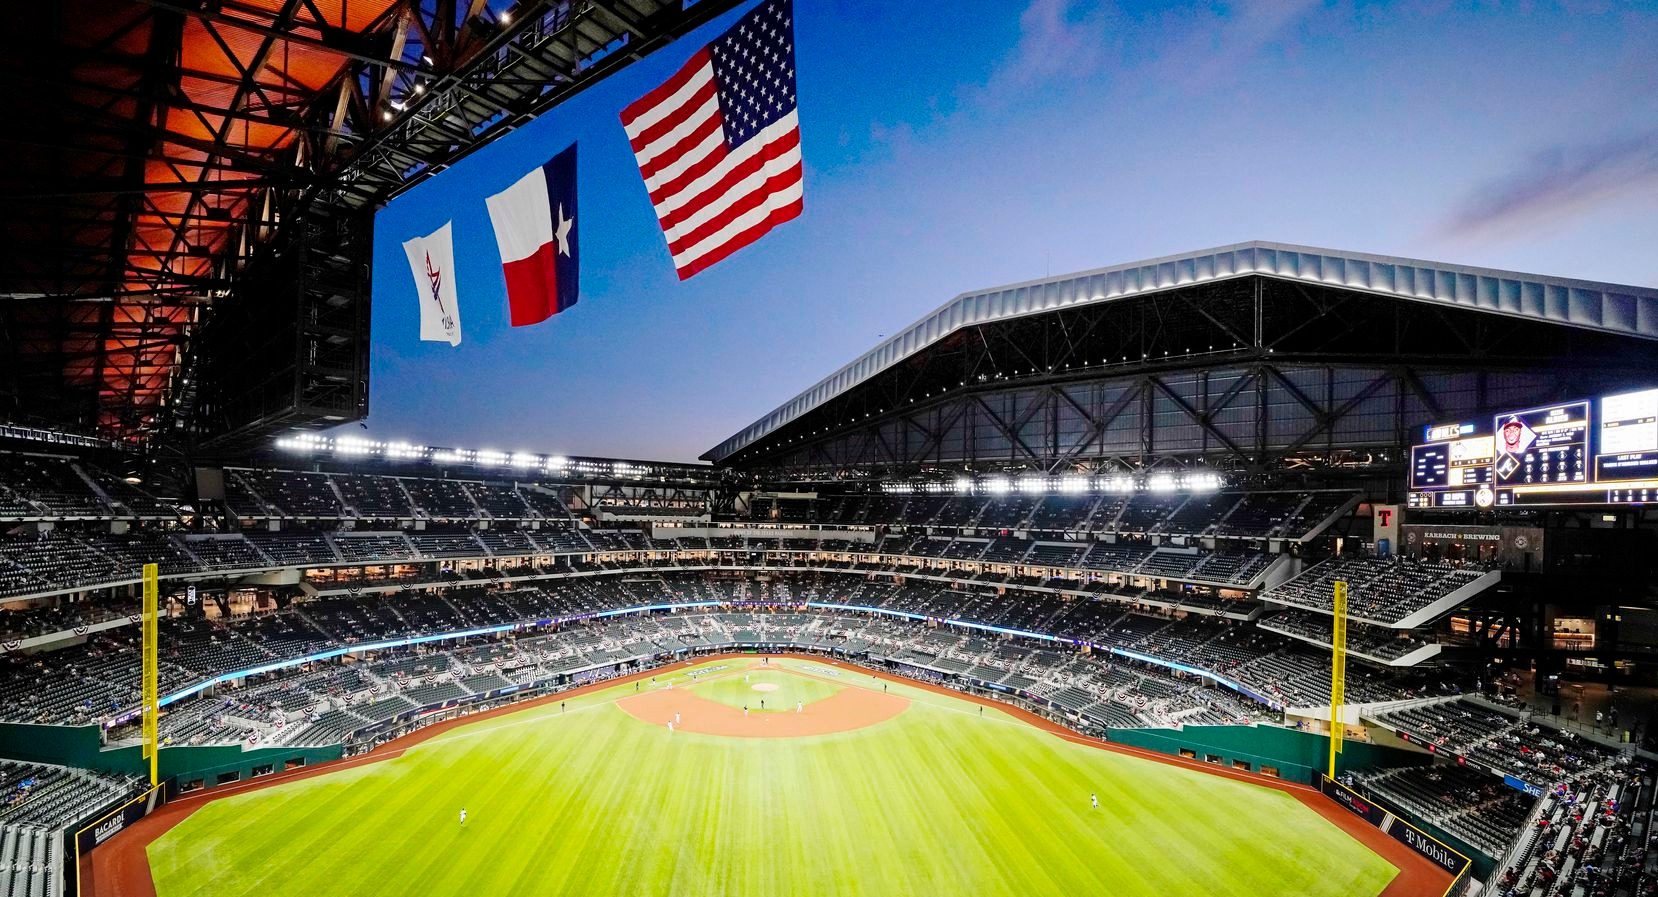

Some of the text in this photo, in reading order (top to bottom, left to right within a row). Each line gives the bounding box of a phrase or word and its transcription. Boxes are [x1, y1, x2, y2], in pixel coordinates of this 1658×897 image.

[1378, 510, 1392, 527] T
[1424, 532, 1500, 541] KARBACH BREWING
[1465, 760, 1481, 771] TOYOTA
[1416, 834, 1455, 869] Mobile
